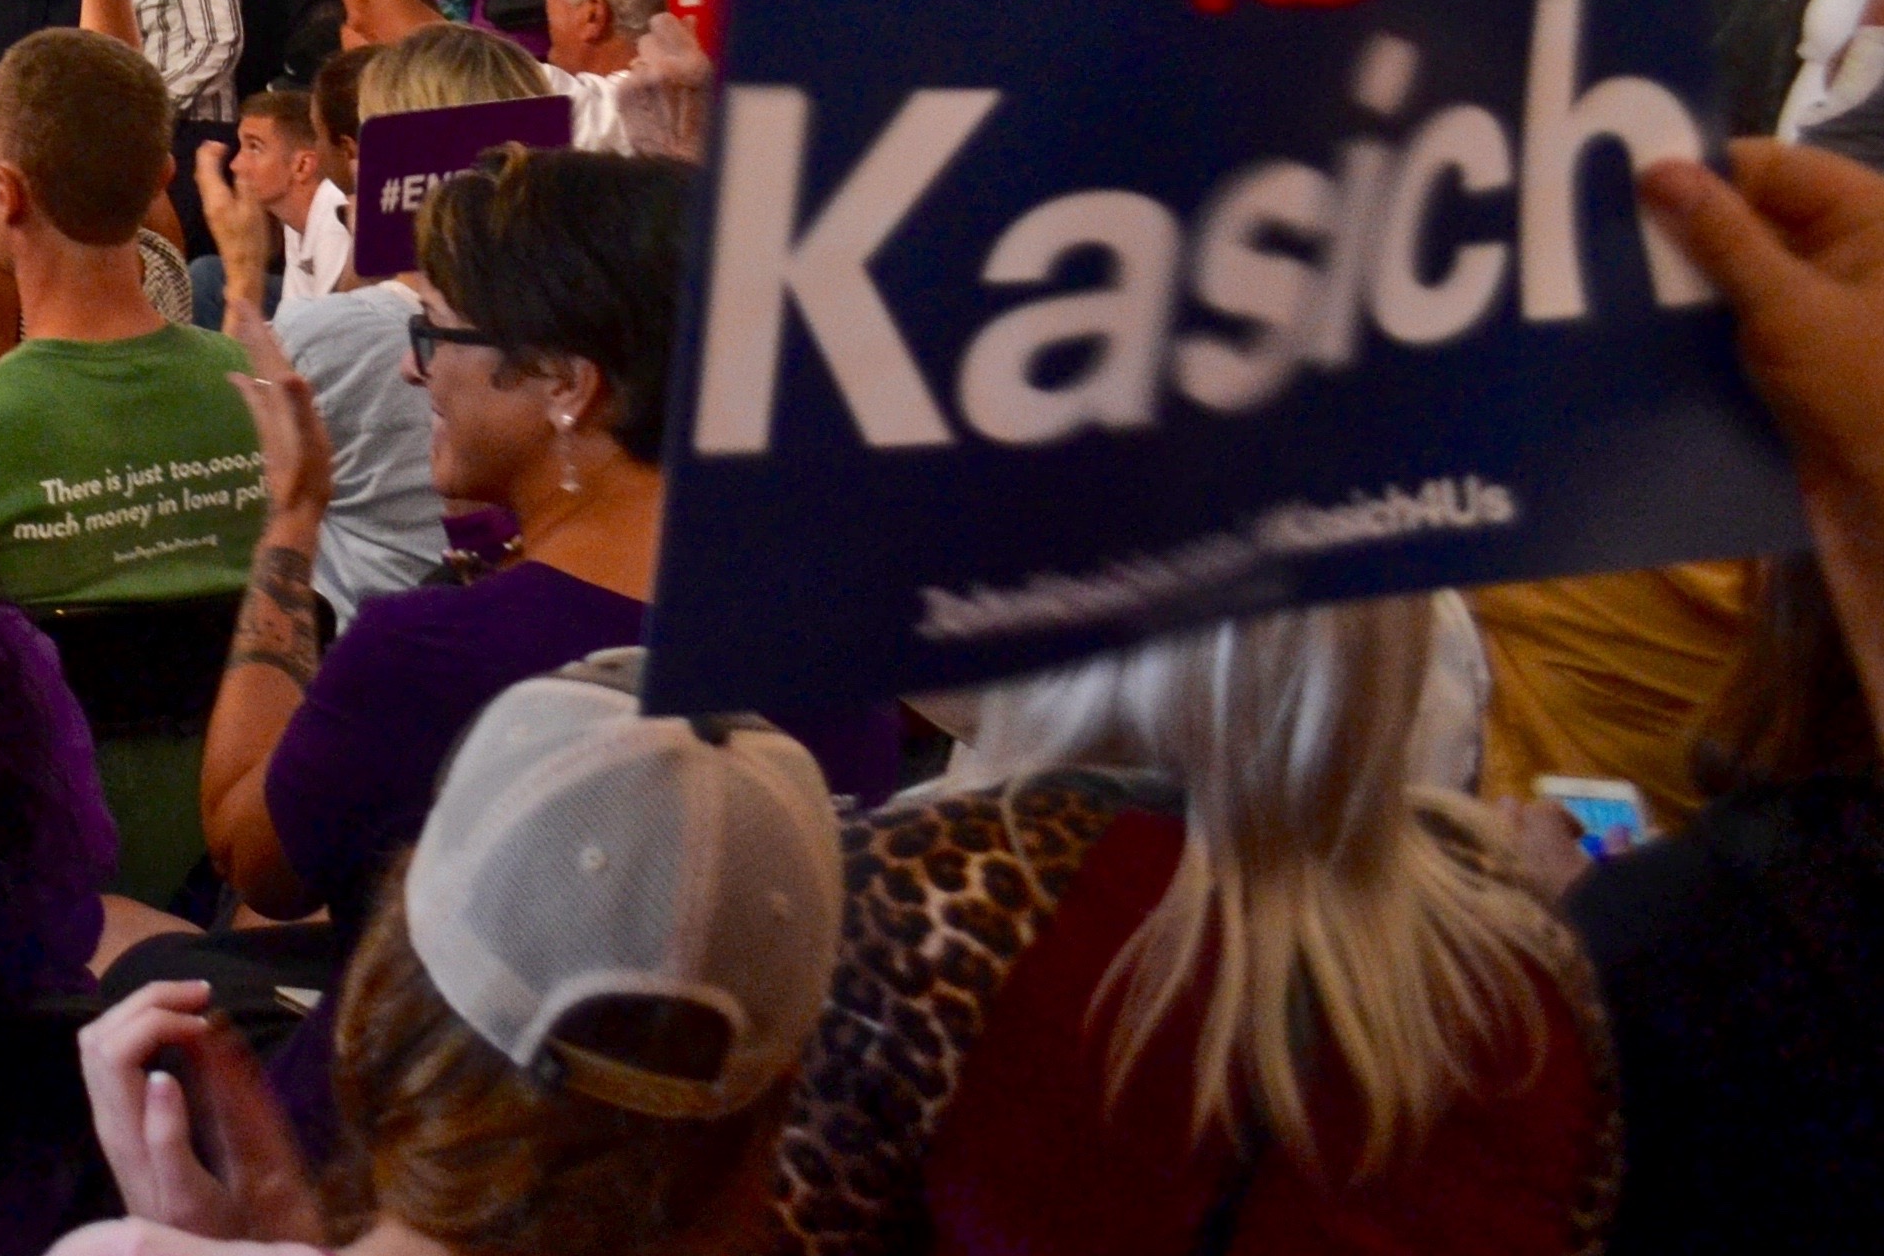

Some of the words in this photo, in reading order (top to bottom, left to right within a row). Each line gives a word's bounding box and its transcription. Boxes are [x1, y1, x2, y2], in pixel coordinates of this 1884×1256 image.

[39, 477, 102, 505] There
[105, 468, 122, 492] is
[124, 463, 164, 497] just
[13, 512, 81, 540] much
[85, 503, 152, 532] money
[157, 493, 179, 516] in
[183, 487, 230, 512] Iowa
